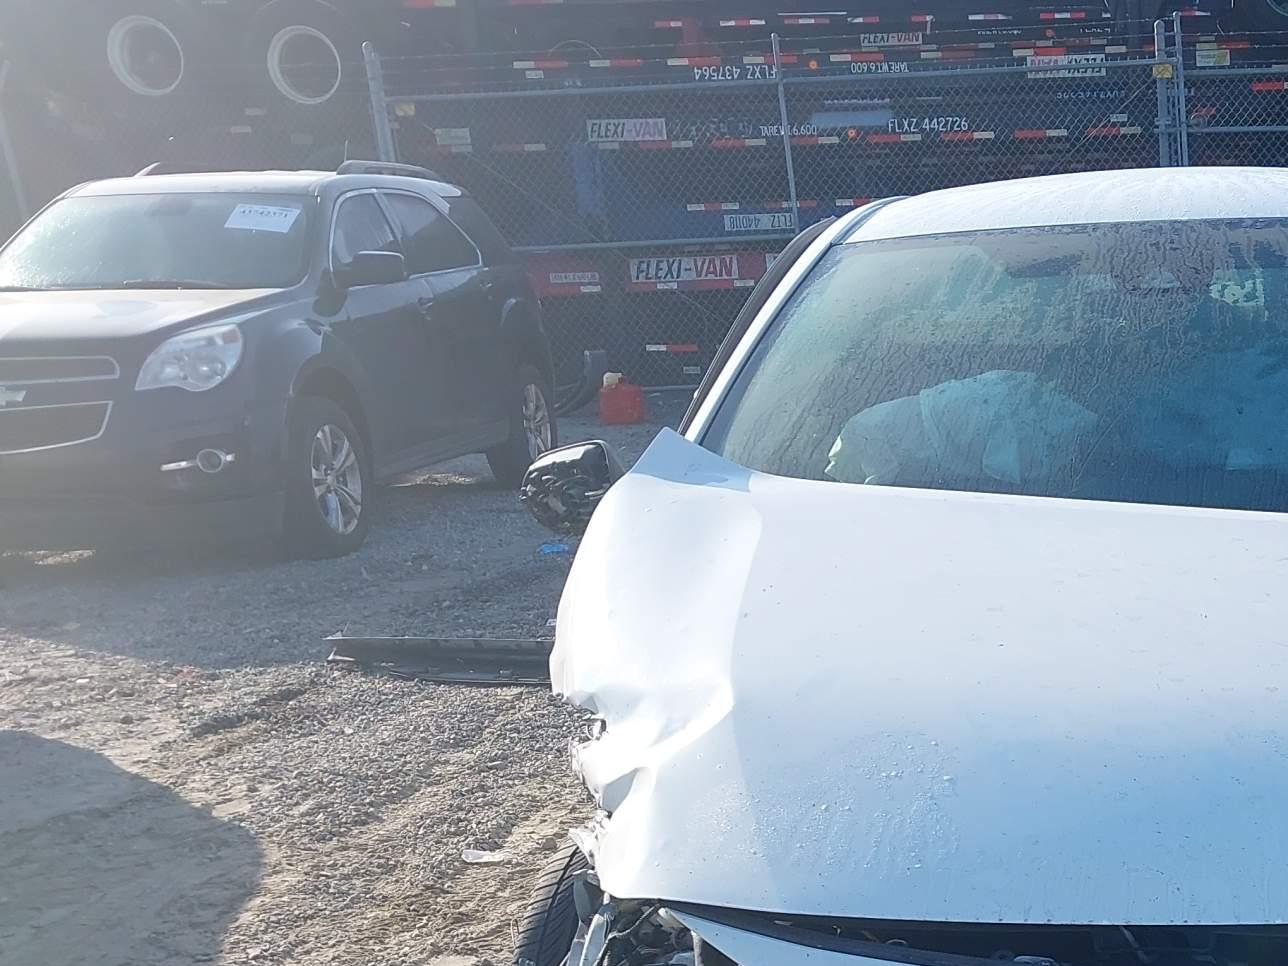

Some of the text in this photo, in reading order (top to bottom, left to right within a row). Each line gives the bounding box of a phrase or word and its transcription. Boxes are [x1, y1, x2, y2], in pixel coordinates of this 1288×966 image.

[861, 32, 920, 44] FLEXI-VAN
[694, 65, 777, 80] FLXZ 437564
[589, 120, 665, 139] FLEXI-VAN
[888, 117, 969, 133] FLXZ 442726
[635, 255, 735, 281] FLEXI-VAN
